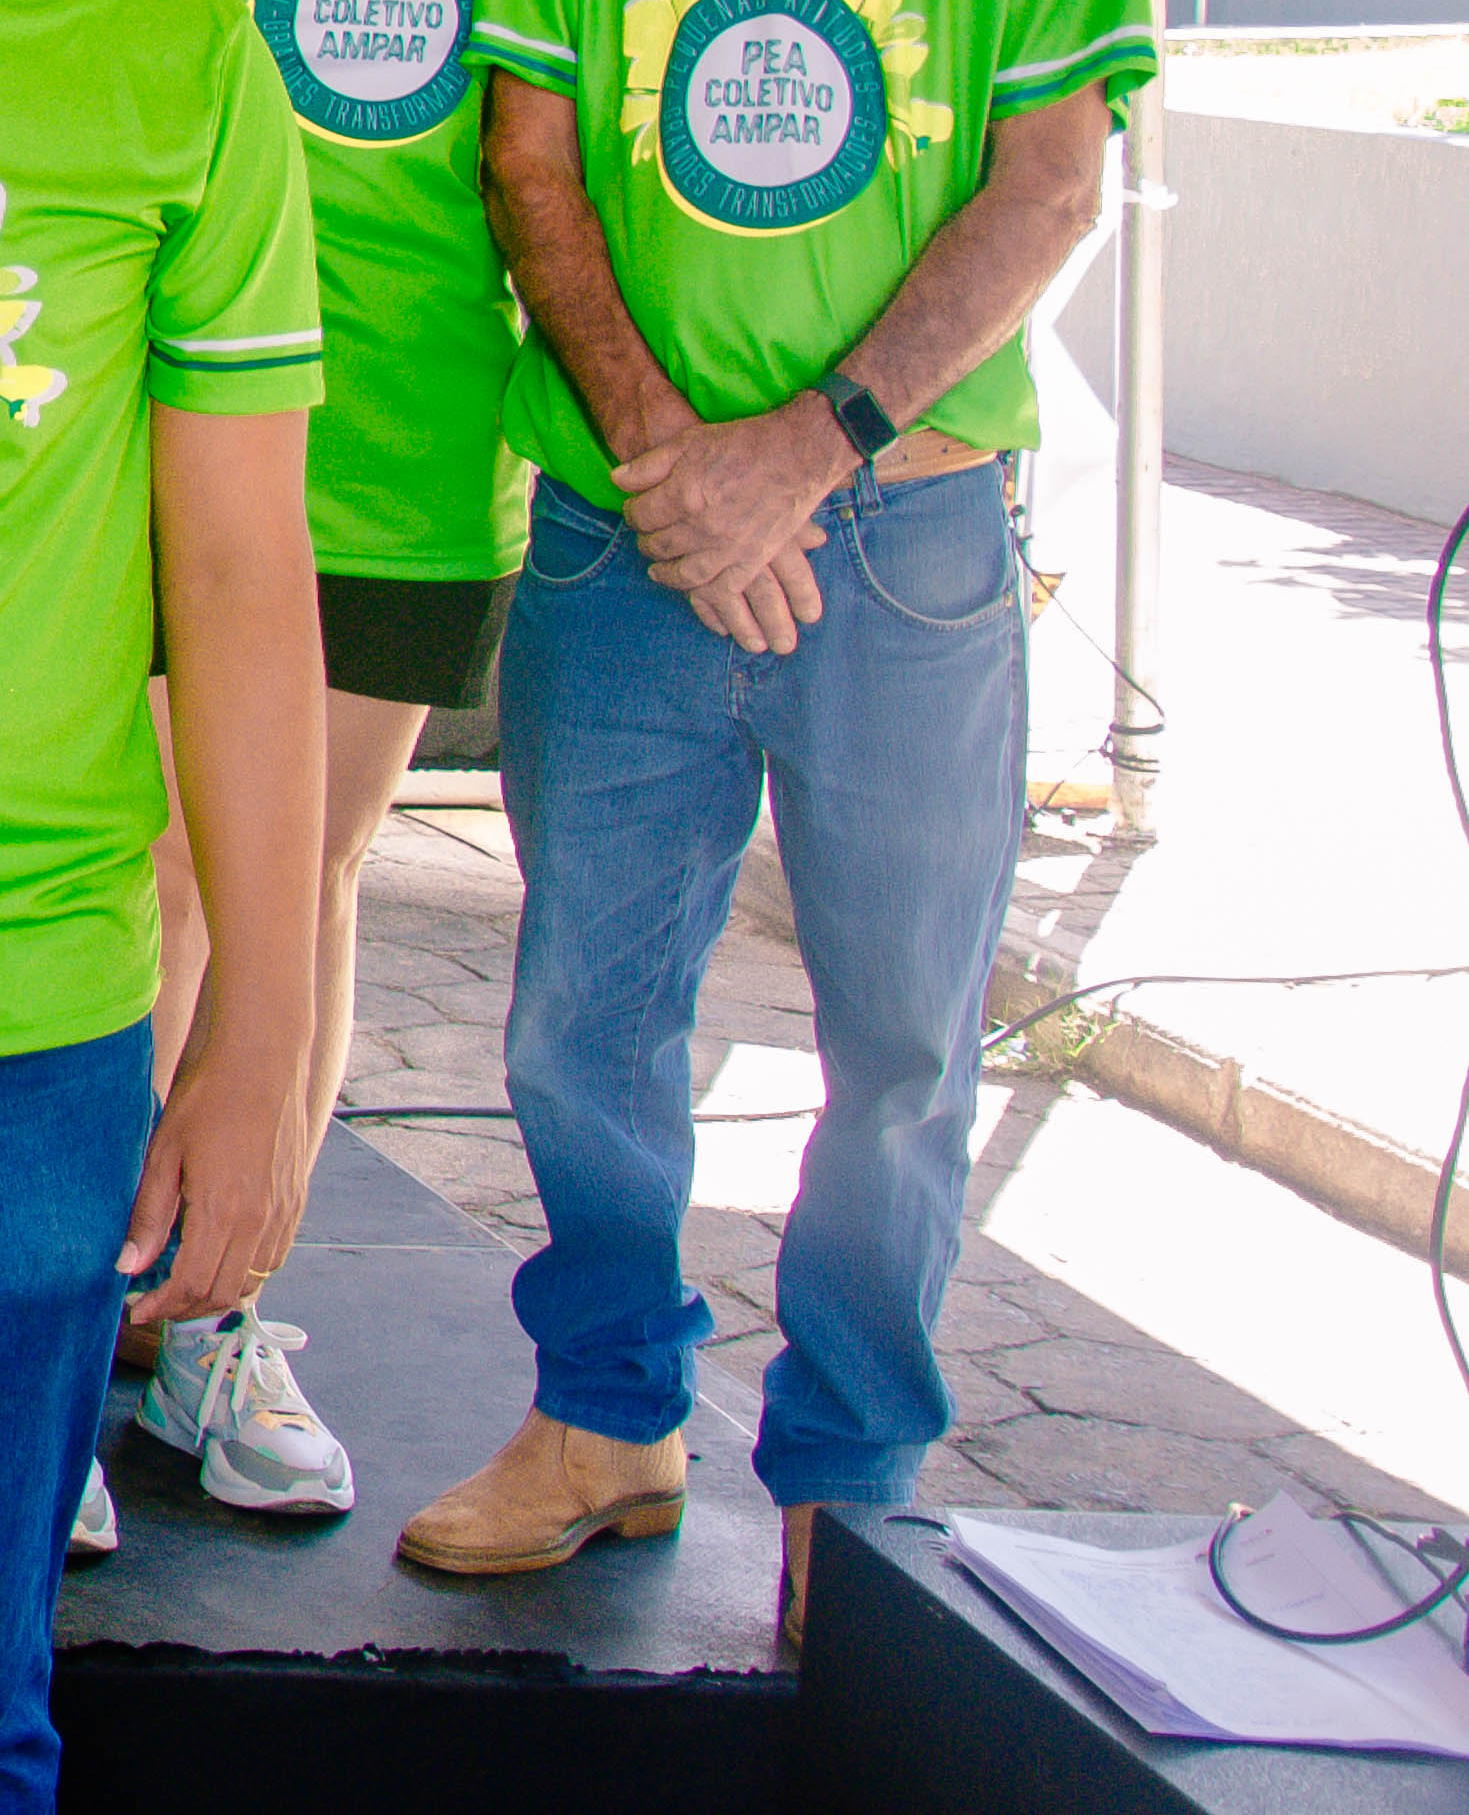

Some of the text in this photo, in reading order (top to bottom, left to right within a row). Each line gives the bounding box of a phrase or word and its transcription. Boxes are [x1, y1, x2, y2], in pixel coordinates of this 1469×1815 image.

[317, 31, 427, 63] AMPAR
[741, 39, 808, 77] PEA
[704, 77, 835, 113] COLETIVO
[710, 113, 822, 145] AMPAR
